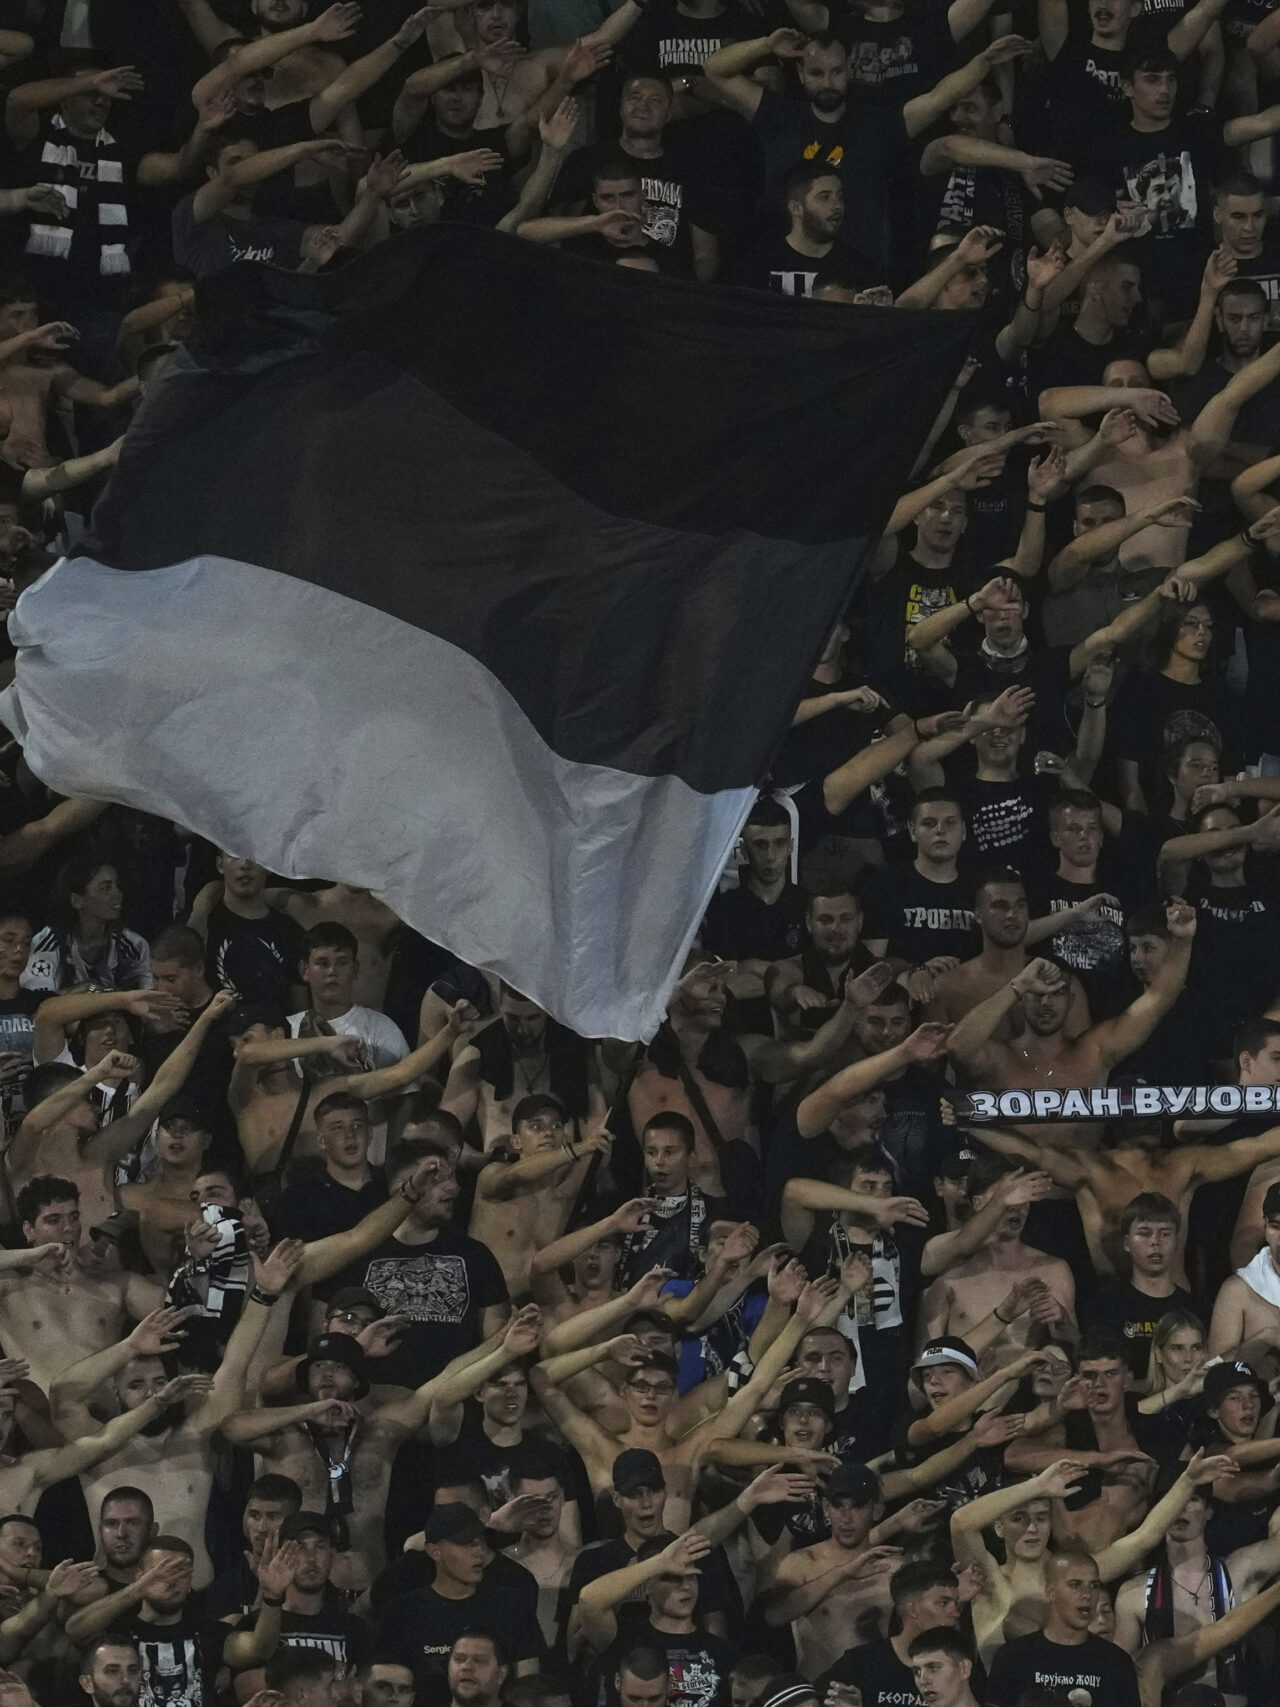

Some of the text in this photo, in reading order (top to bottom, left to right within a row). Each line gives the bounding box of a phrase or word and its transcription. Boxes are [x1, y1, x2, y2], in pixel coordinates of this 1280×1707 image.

[904, 907, 976, 930] ГРОБАР
[970, 1087, 1123, 1120] ЗОРАН
[1035, 1672, 1074, 1688] Верујемо
